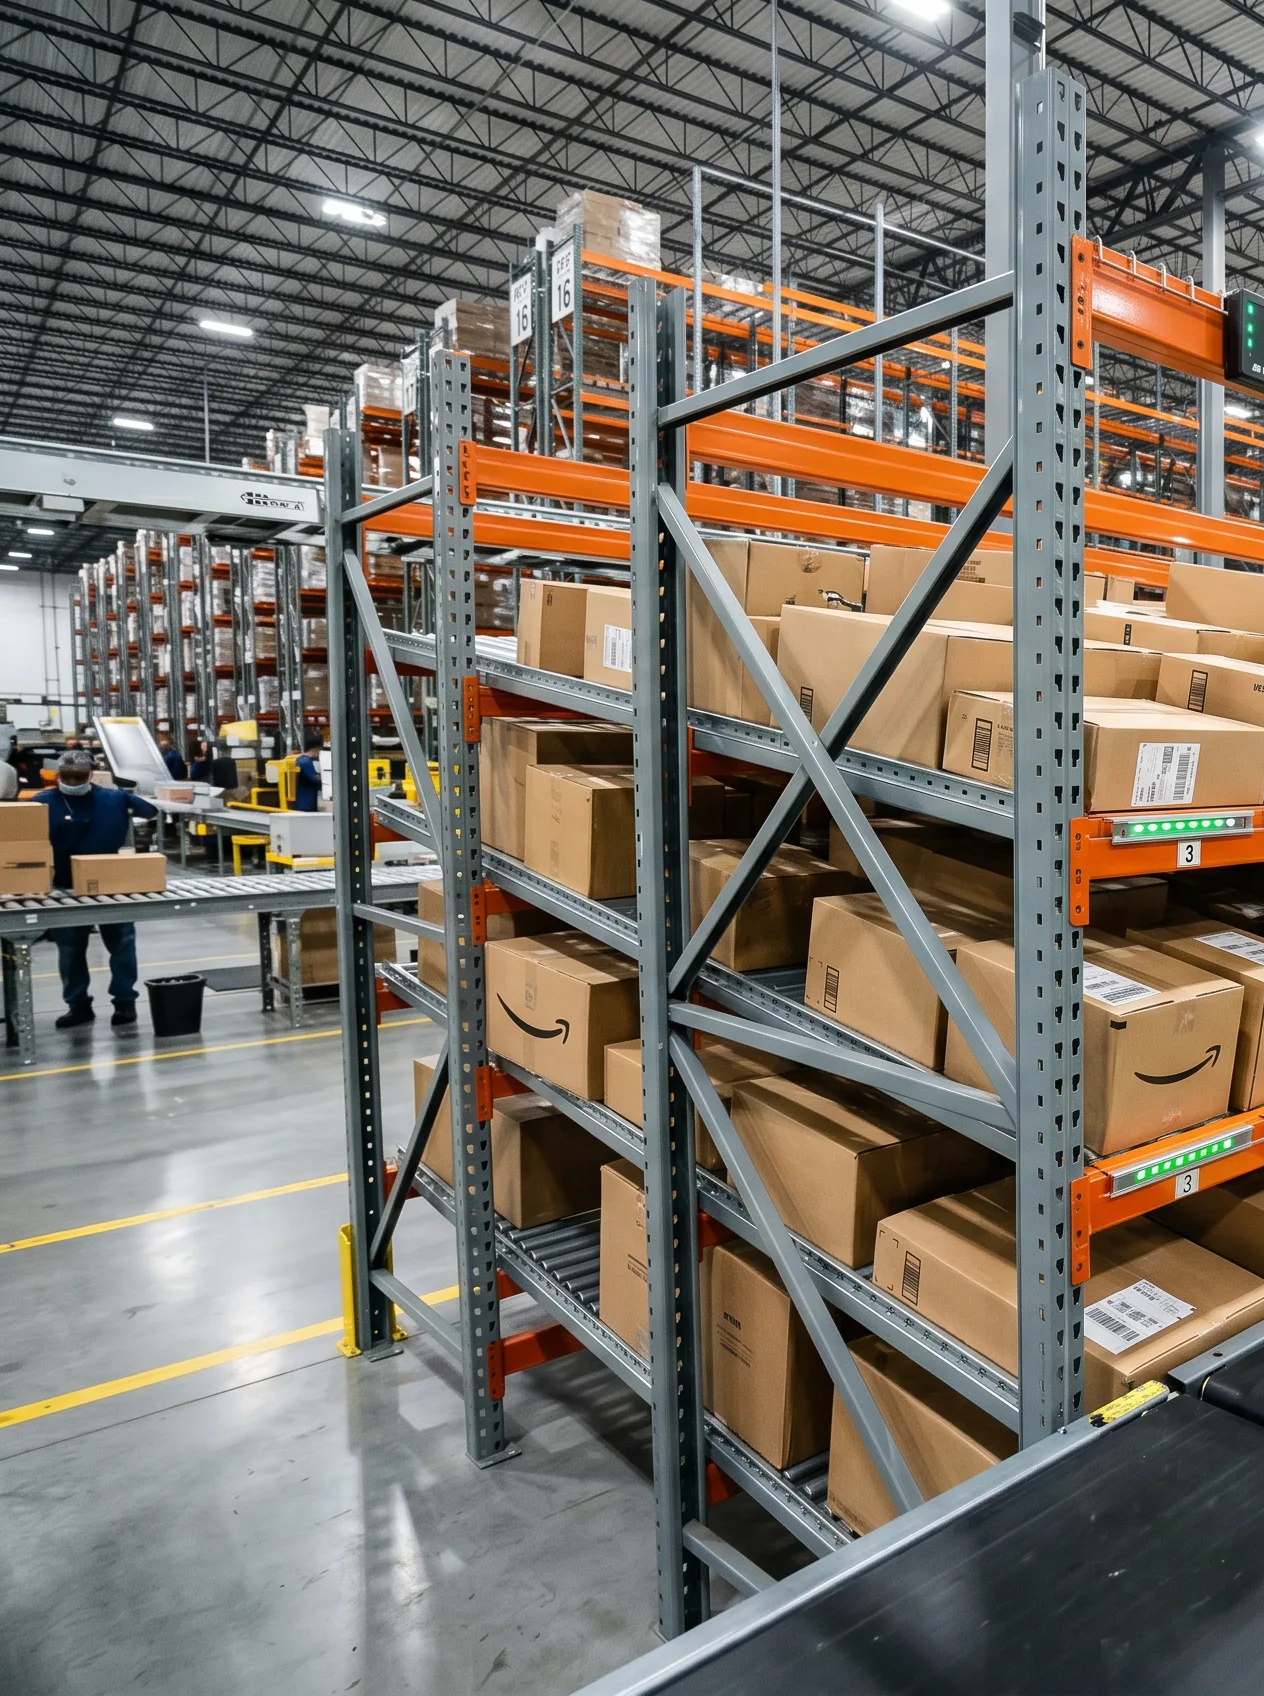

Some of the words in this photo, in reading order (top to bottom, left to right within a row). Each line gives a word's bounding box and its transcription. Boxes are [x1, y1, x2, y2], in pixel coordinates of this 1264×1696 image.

[557, 279, 571, 312] 16
[516, 304, 529, 336] 16
[1185, 844, 1194, 863] 3
[1183, 1174, 1192, 1193] 3
